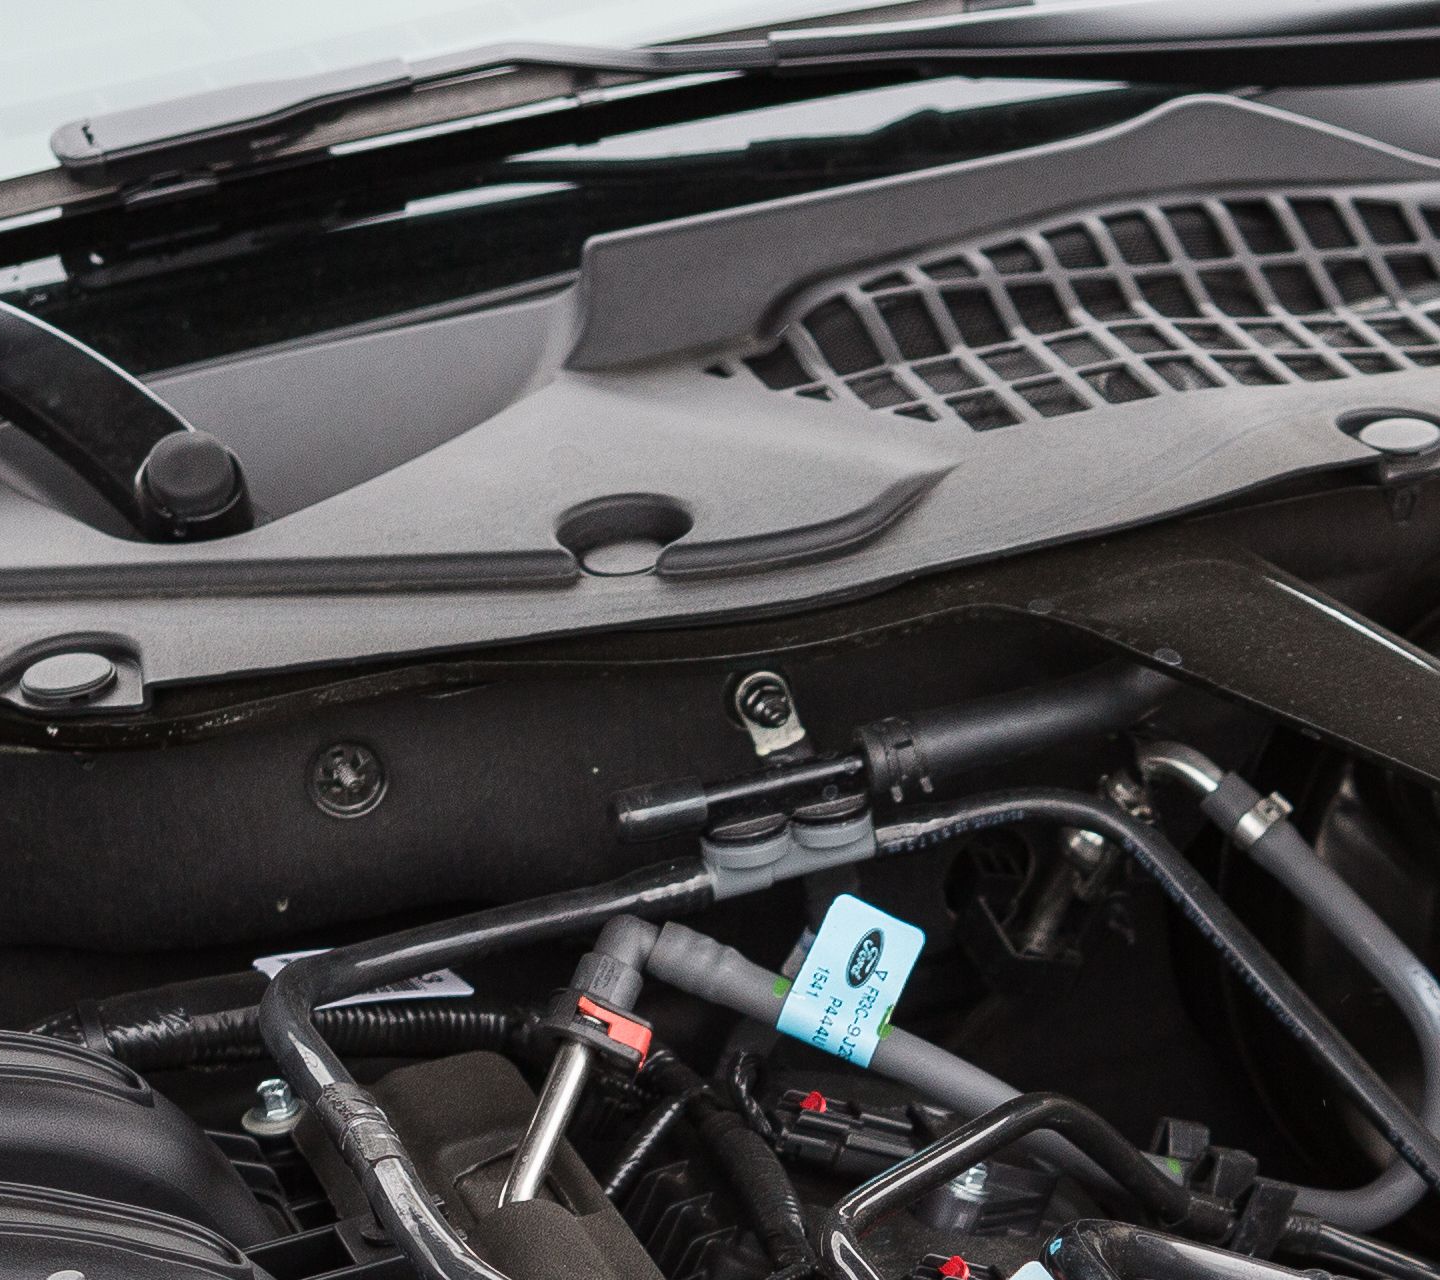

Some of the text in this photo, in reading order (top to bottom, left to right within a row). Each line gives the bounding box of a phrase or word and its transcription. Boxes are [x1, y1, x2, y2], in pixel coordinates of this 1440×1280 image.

[806, 967, 830, 997] 1541
[849, 936, 880, 982] Ford
[838, 985, 879, 1060] FR3C-9J2
